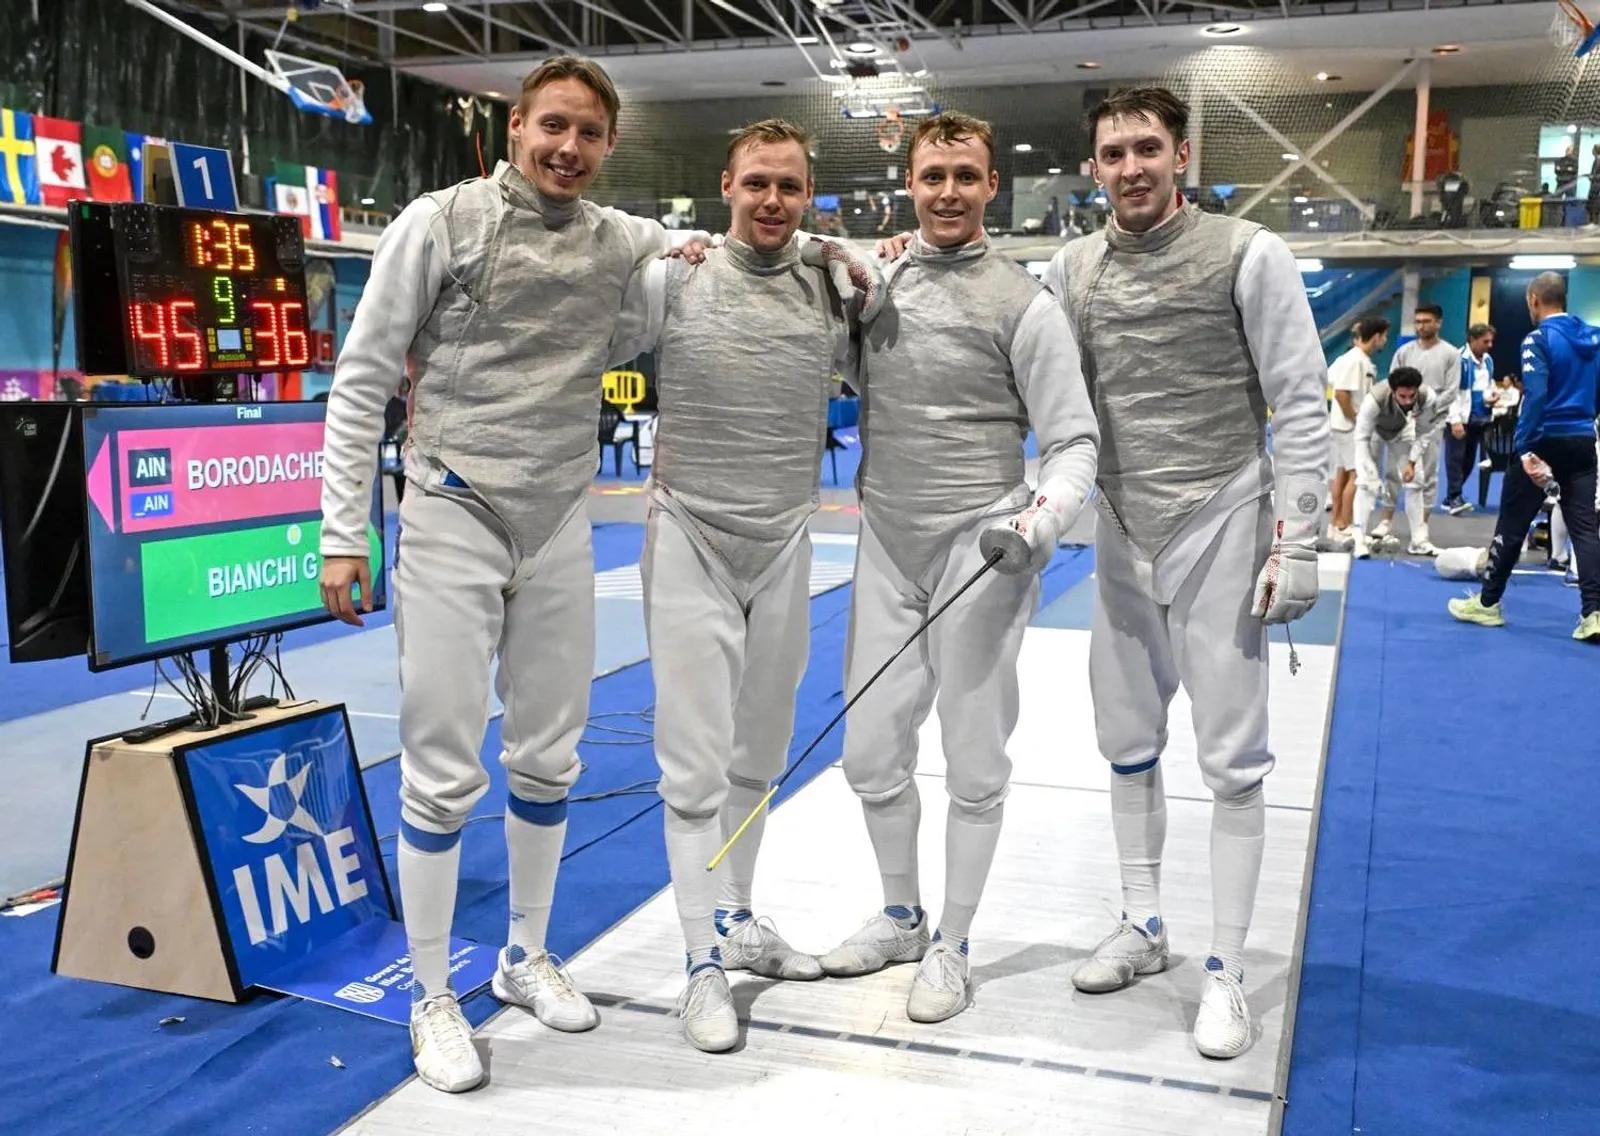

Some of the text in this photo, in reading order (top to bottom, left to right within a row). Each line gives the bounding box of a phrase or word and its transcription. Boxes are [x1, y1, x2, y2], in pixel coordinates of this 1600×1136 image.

[193, 156, 215, 200] 1
[194, 220, 255, 270] 1:35
[214, 276, 236, 323] 9
[252, 303, 308, 366] 36
[236, 406, 262, 419] Final
[136, 456, 166, 479] AIN
[208, 552, 318, 597] BIANCHI G
[232, 826, 368, 946] IME
